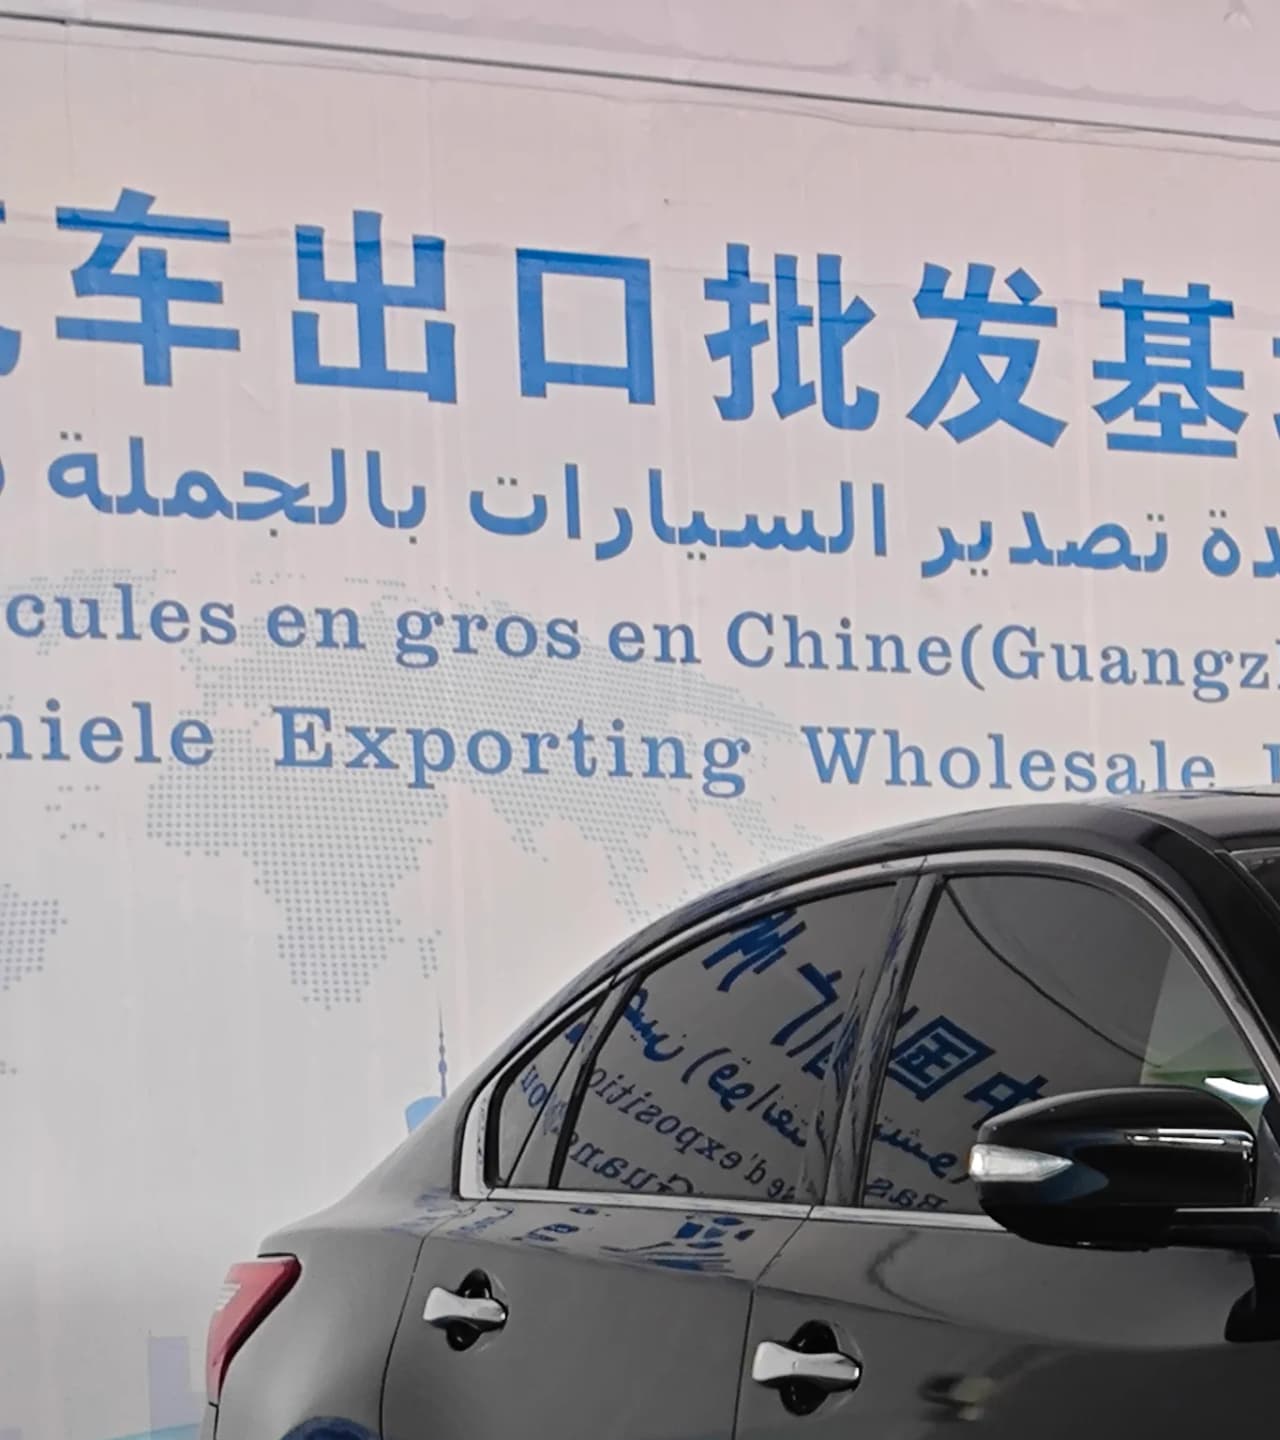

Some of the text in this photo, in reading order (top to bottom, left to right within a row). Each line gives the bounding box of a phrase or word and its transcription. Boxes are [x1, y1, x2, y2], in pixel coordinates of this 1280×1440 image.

[48, 431, 426, 545] بالجملة
[469, 463, 888, 561] السيارات
[921, 511, 1169, 579] تصدير
[266, 605, 367, 650] en
[395, 612, 582, 669] gros
[607, 623, 701, 666] en
[271, 704, 750, 798] Exporting
[800, 725, 1216, 797] Wholesale
